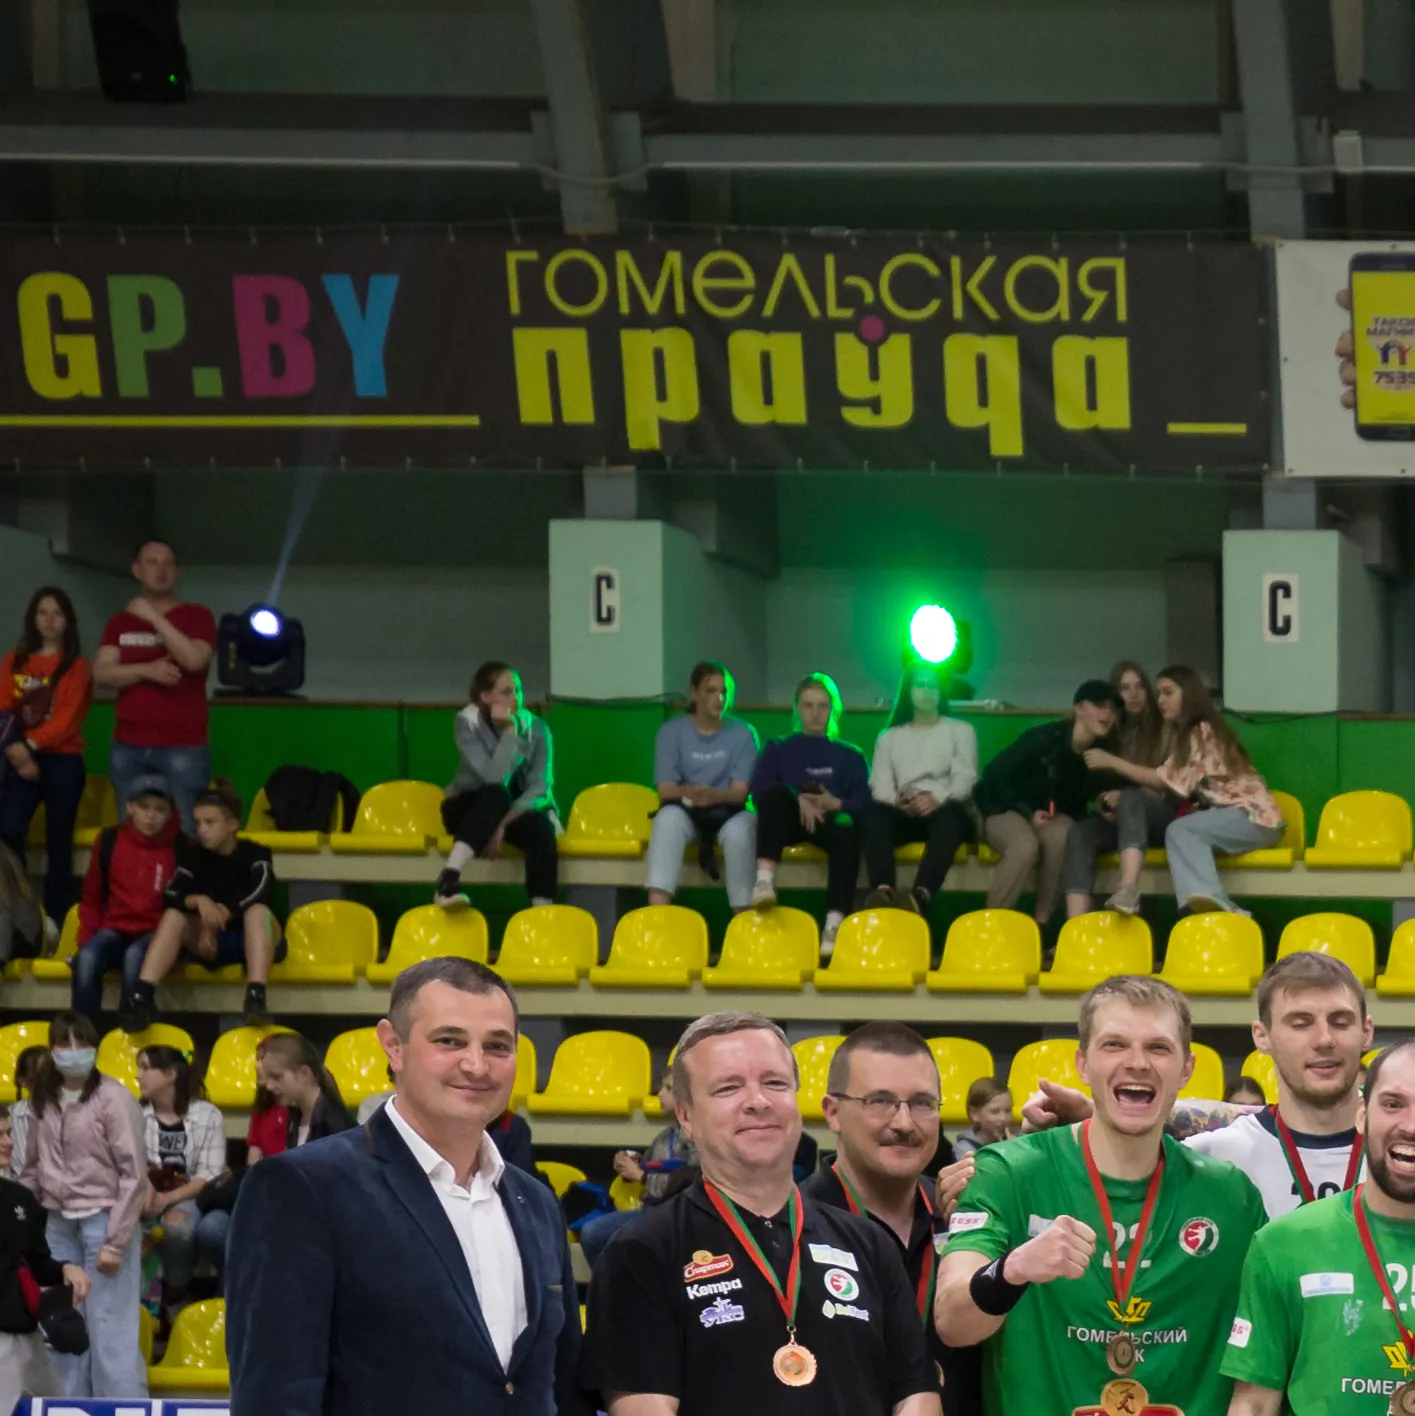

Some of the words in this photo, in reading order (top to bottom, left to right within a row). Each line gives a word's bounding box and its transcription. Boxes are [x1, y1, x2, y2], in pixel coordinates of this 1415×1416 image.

[17, 271, 400, 398] GP.BY
[687, 1279, 742, 1299] Kempa
[1067, 1325, 1188, 1344] ГОМЕЬСКИЙ
